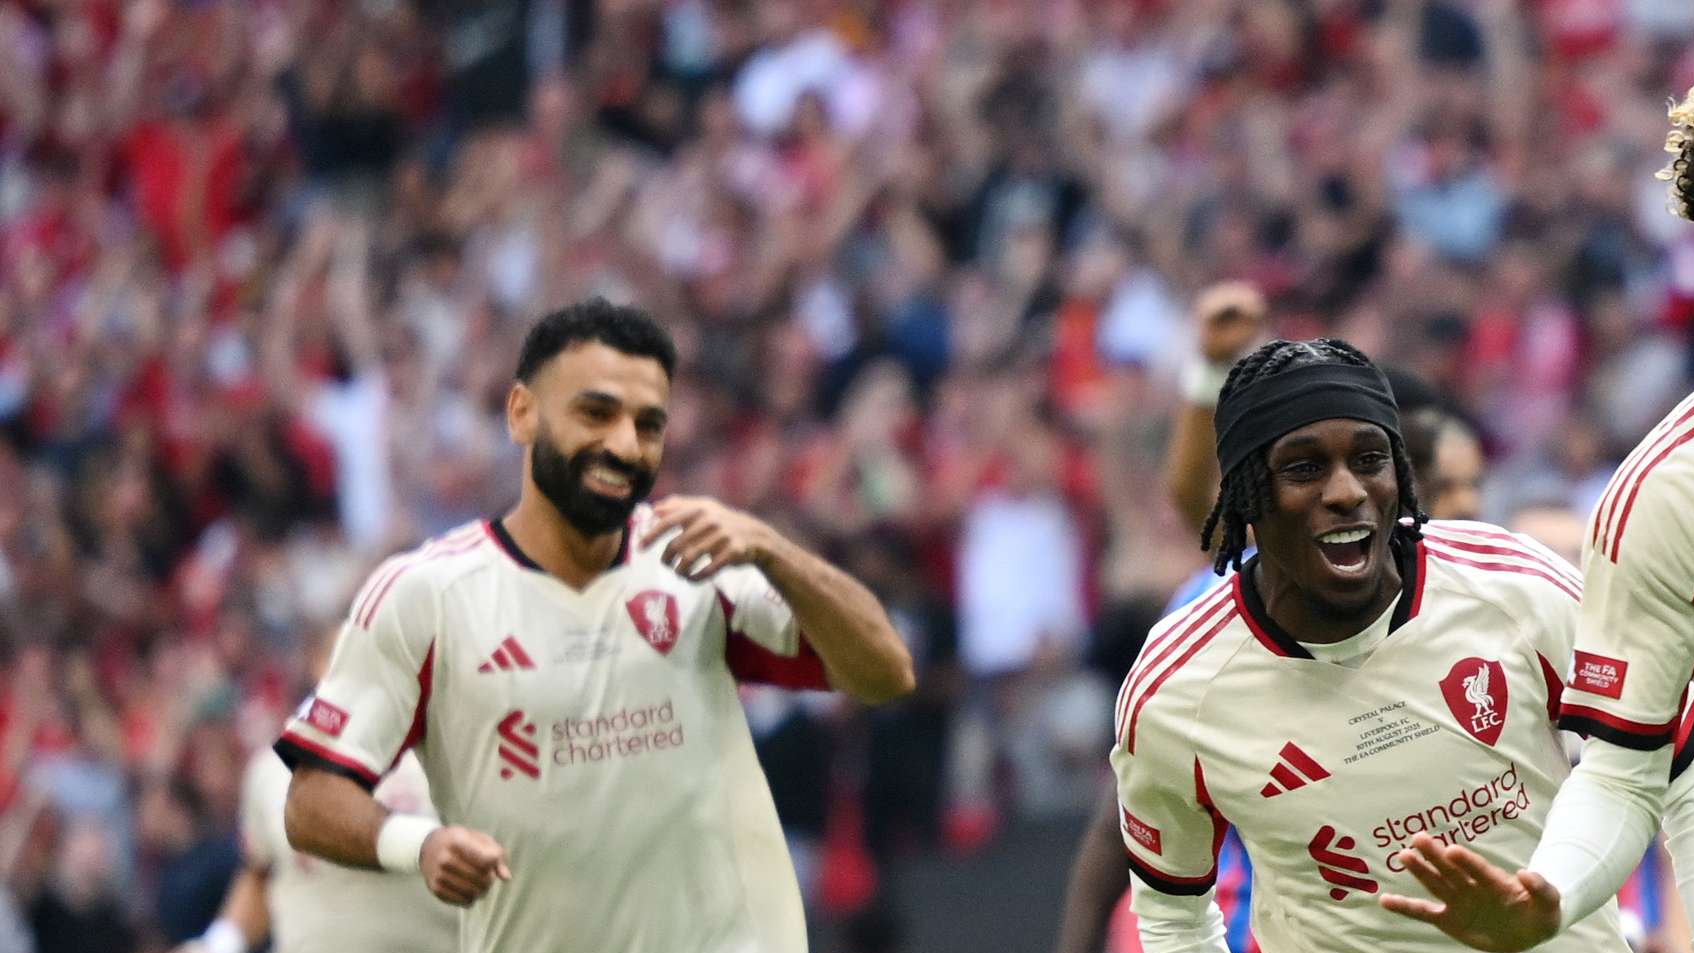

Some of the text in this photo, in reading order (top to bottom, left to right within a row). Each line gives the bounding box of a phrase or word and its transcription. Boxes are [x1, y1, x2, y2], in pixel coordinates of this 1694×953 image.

[1584, 661, 1617, 677] THE FA
[551, 697, 674, 741] standard
[1348, 700, 1406, 726] CRYSTAL PALACE
[553, 723, 684, 766] chartered
[1360, 721, 1400, 740] LIVERPOOL
[1375, 728, 1402, 743] AUGUST
[1344, 754, 1359, 765] THE
[1369, 734, 1413, 755] COMMUNITY
[1373, 761, 1517, 848] standard
[1386, 782, 1530, 872] crtered
